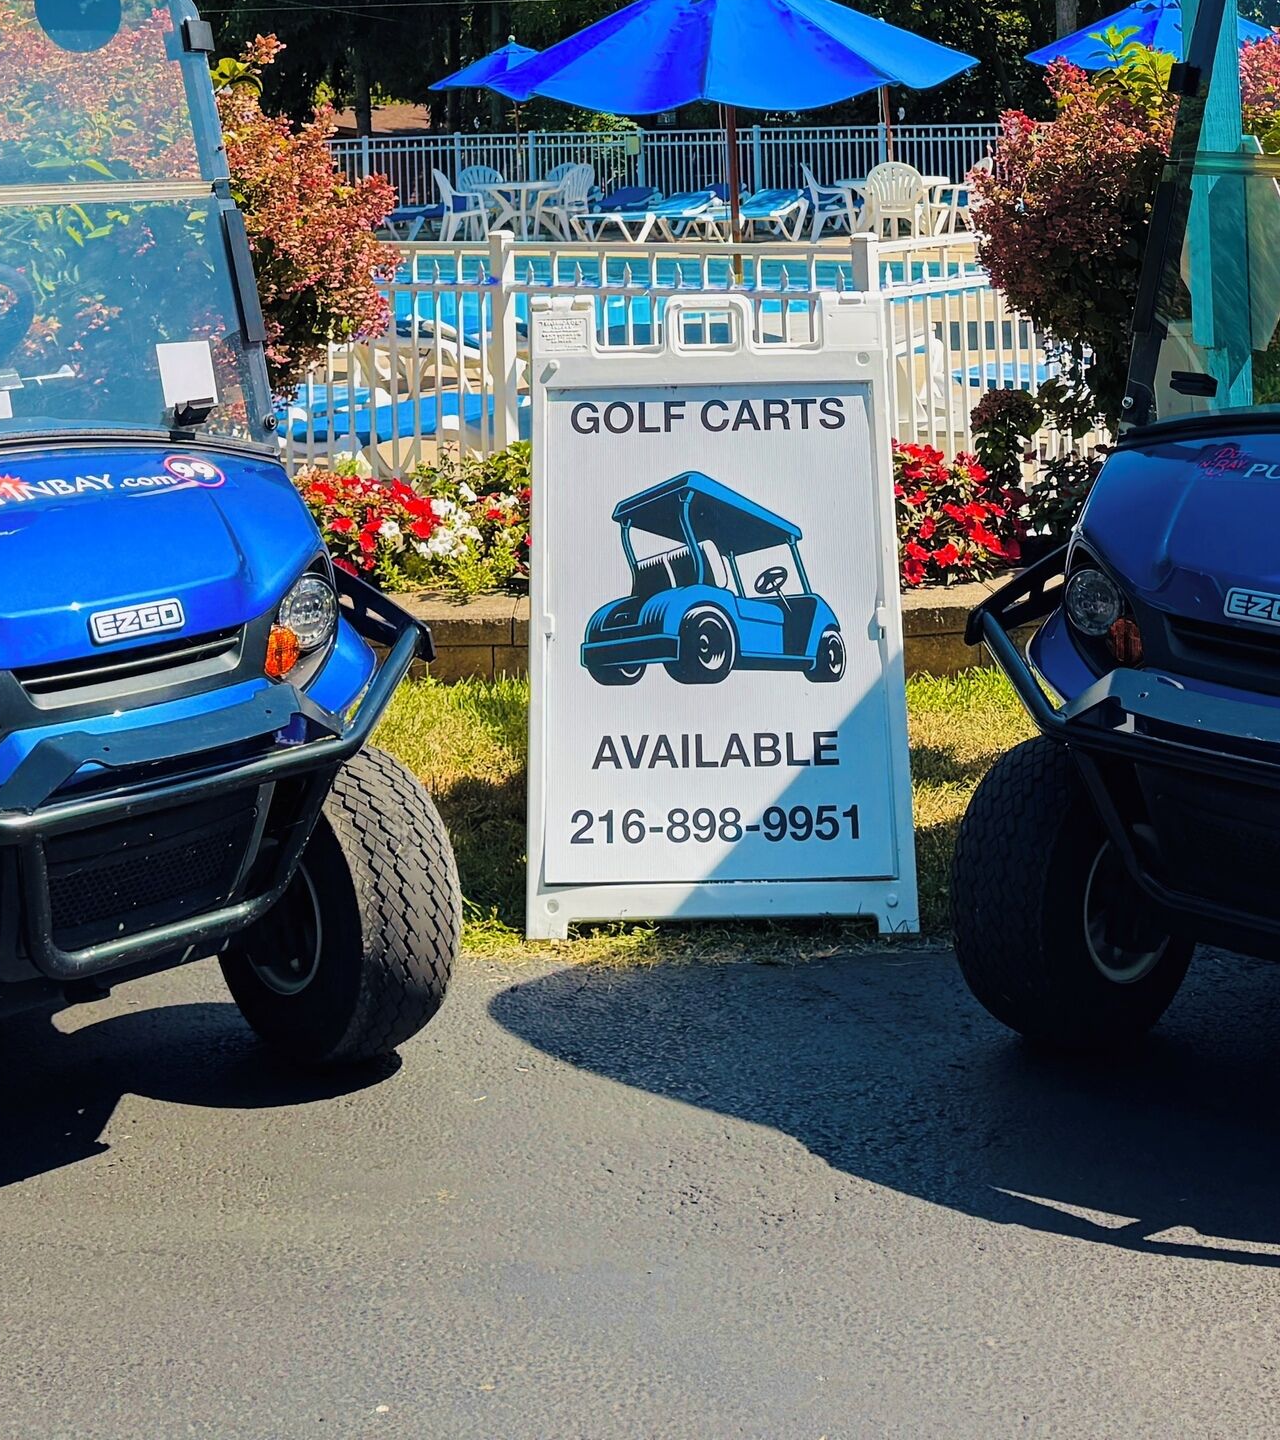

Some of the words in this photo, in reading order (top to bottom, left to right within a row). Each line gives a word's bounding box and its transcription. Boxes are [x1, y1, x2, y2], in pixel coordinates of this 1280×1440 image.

[571, 401, 686, 435] GOLF
[700, 397, 847, 433] CARTS
[169, 461, 216, 480] 99
[592, 731, 841, 771] AVAILABLE
[570, 803, 862, 846] 216-898-9951
